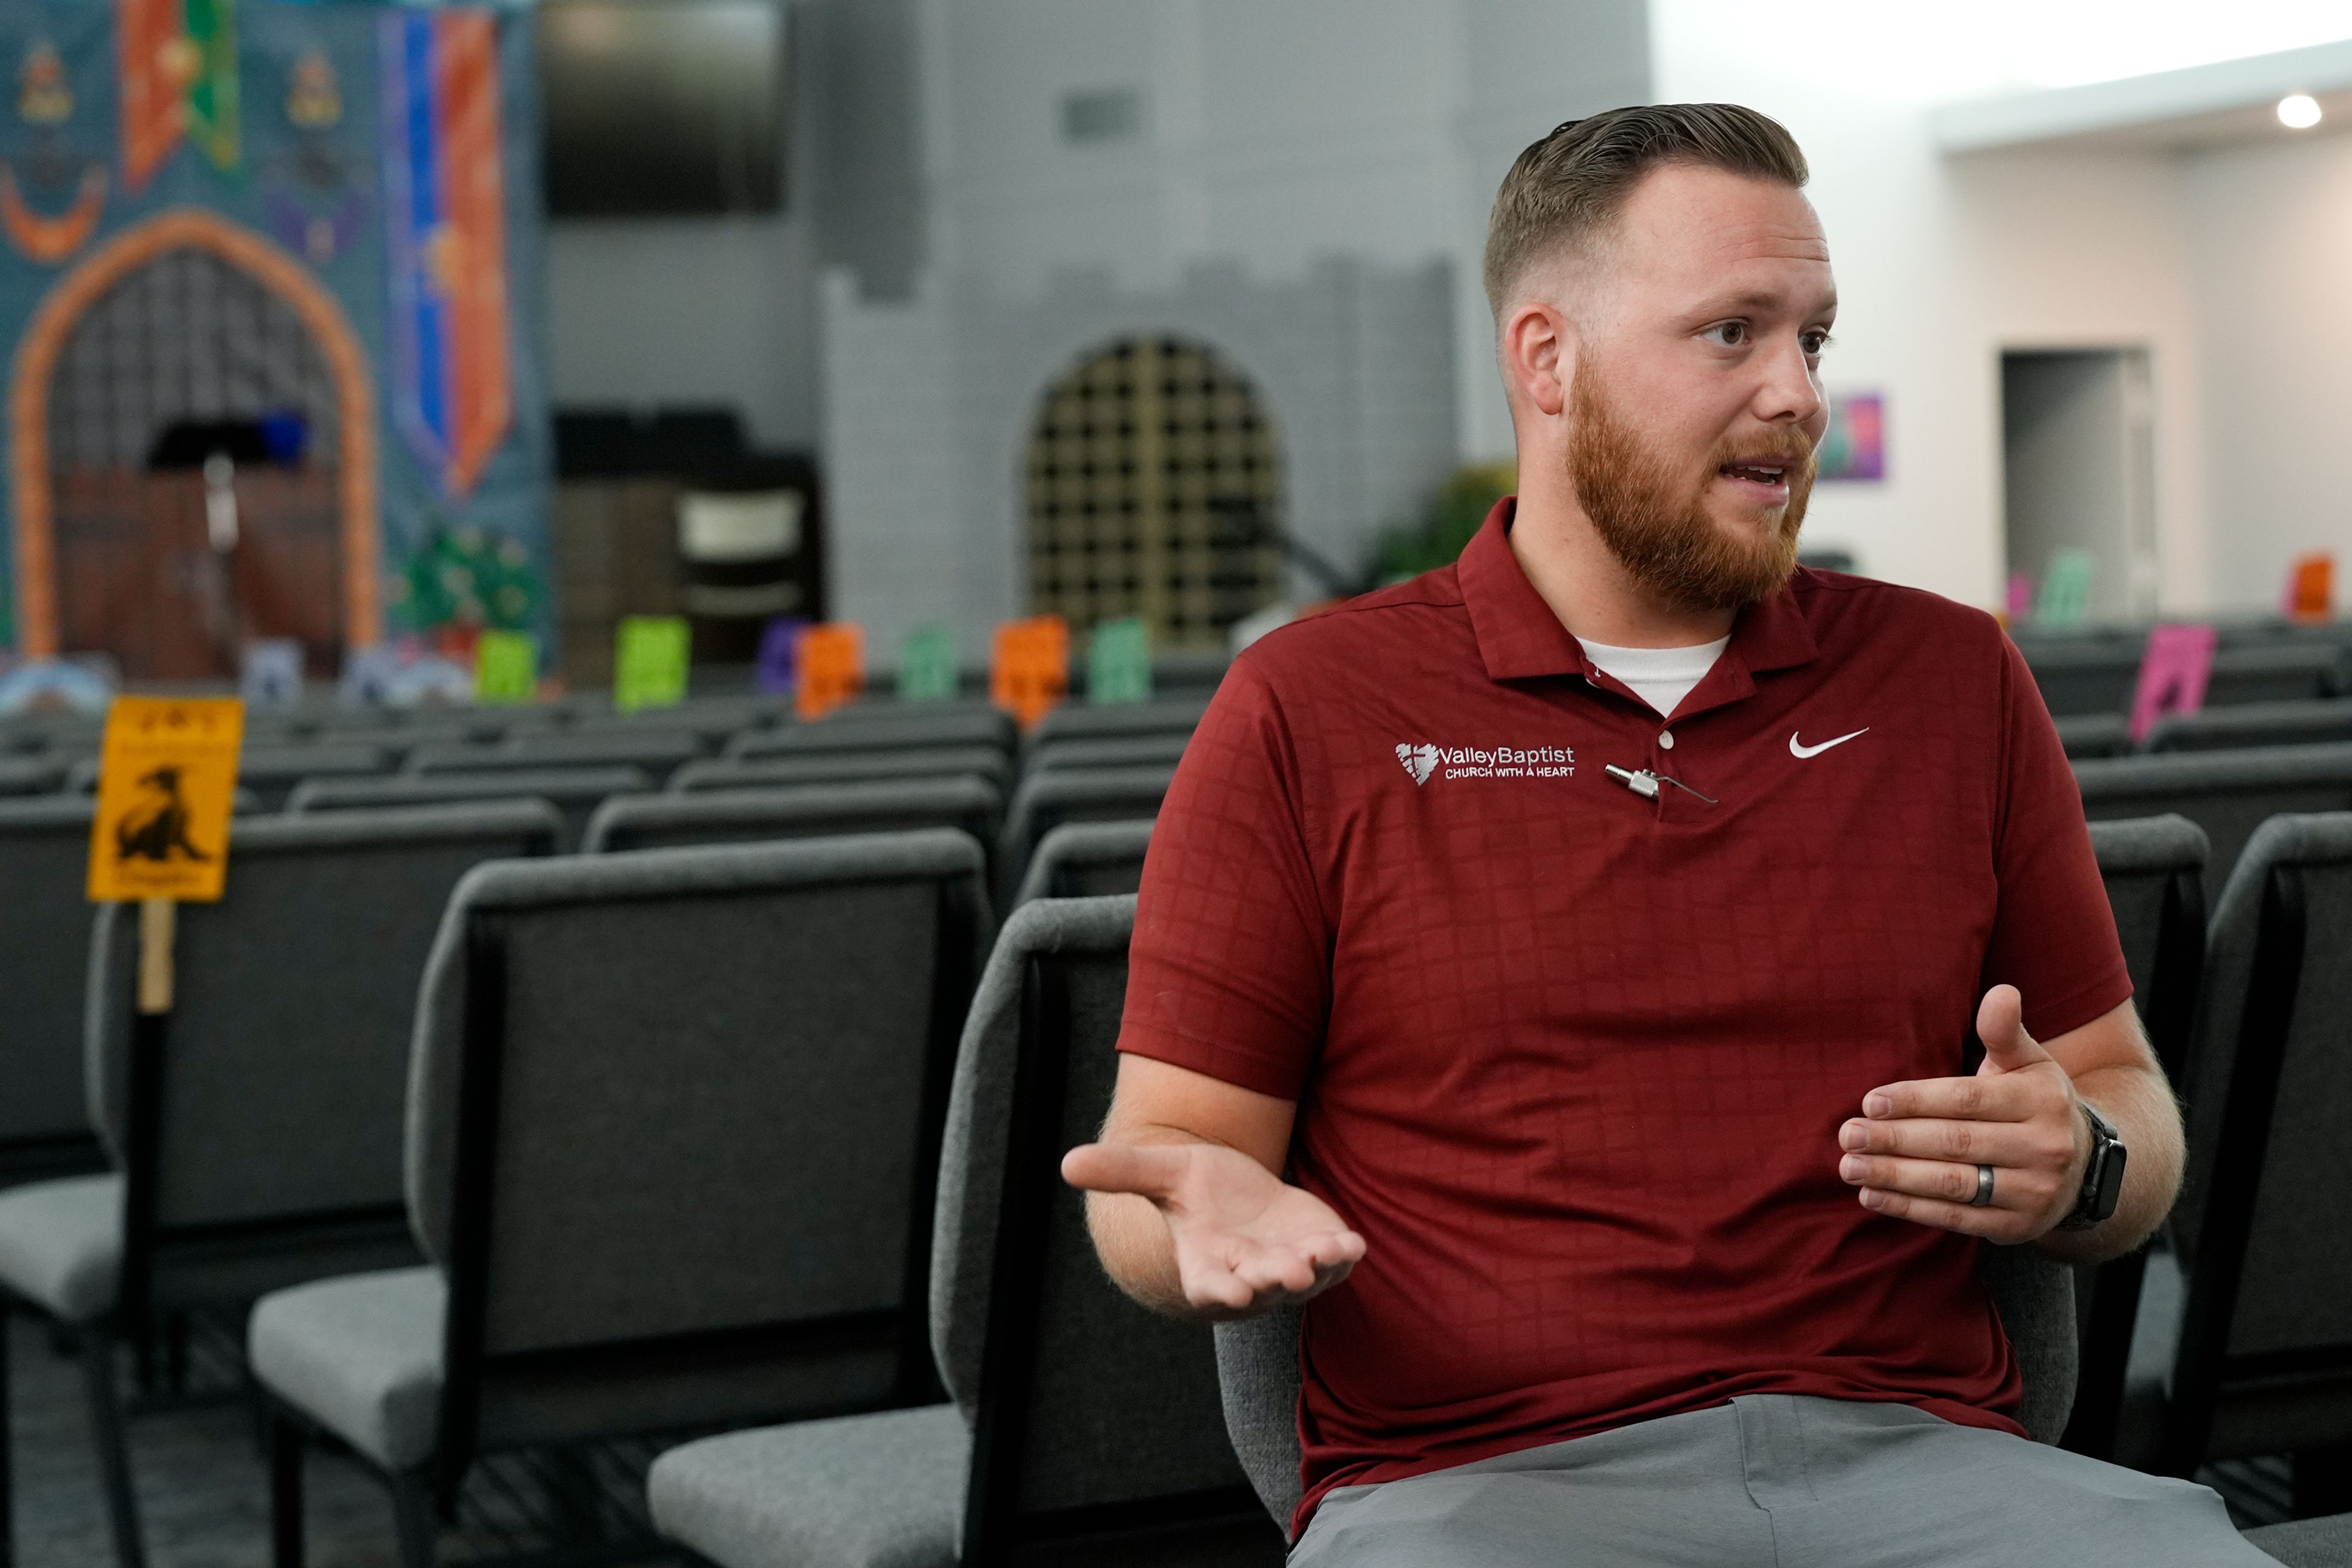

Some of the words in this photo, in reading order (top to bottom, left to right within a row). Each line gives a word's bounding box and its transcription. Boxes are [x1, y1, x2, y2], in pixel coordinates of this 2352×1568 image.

[1445, 767, 1492, 780] CHURCH
[1496, 767, 1524, 778] WITH
[1526, 766, 1535, 777] A
[1536, 766, 1575, 777] HEART
